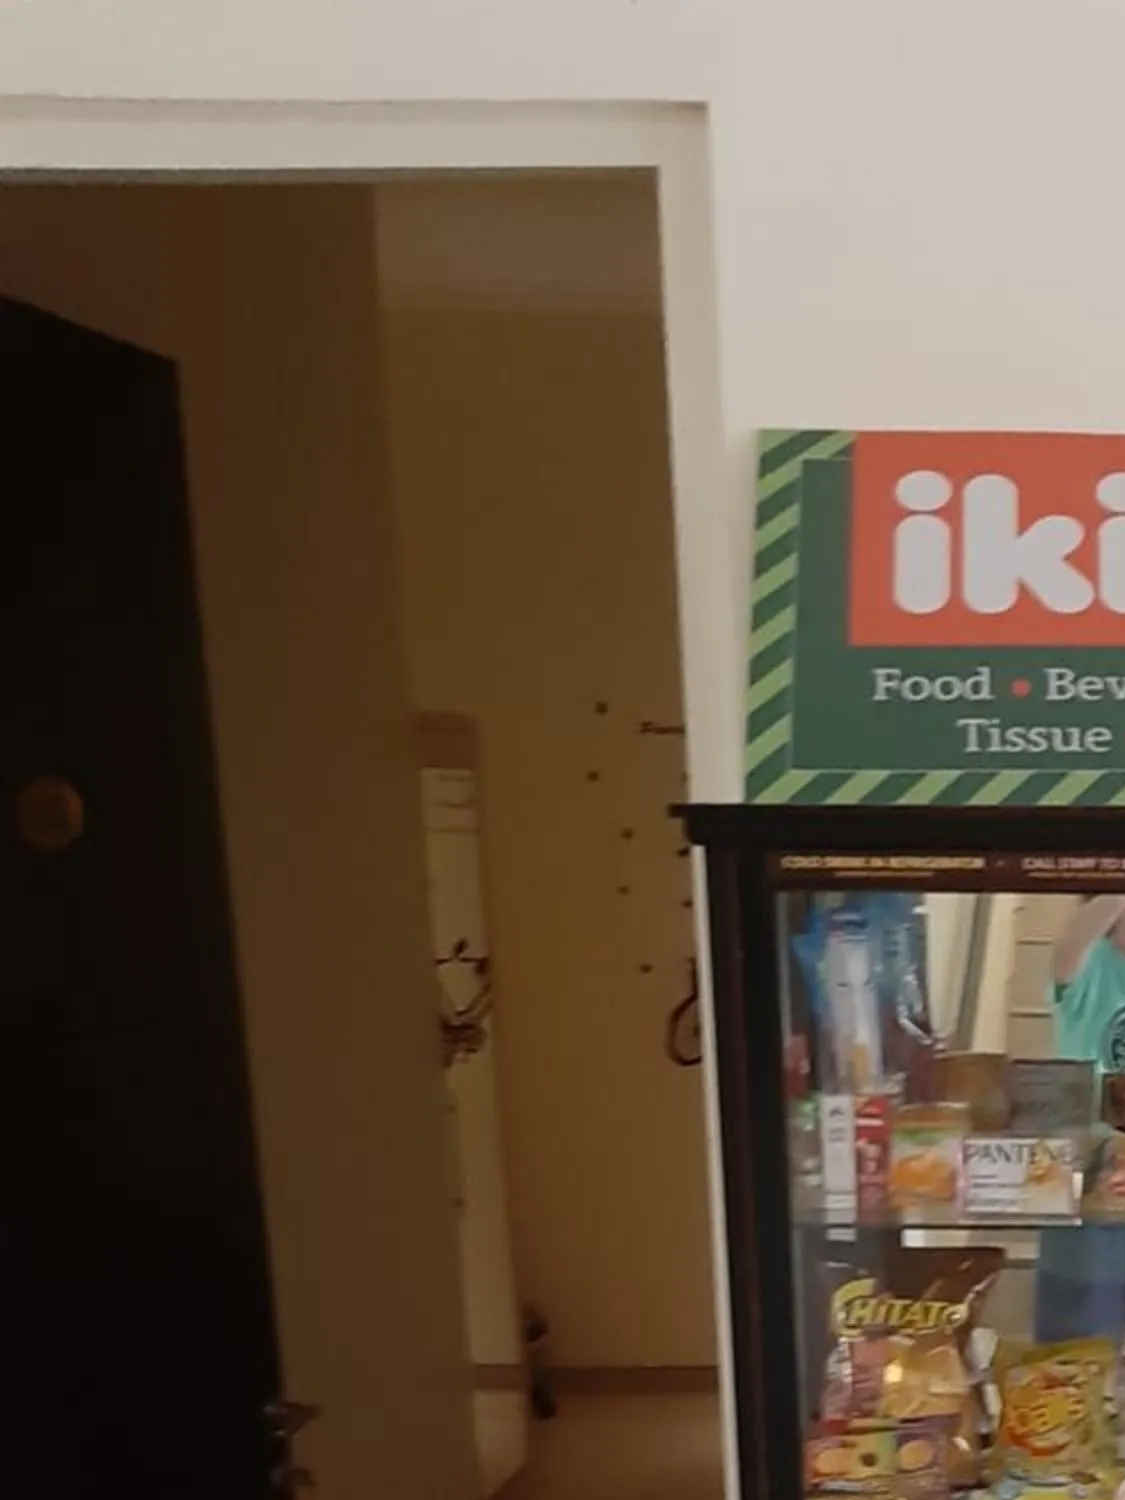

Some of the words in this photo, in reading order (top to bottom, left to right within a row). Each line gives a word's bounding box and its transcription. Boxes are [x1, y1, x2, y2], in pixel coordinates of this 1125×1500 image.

[871, 665, 996, 702] Food
[955, 716, 1114, 754] Tissue
[832, 1277, 969, 1337] CHITATO
